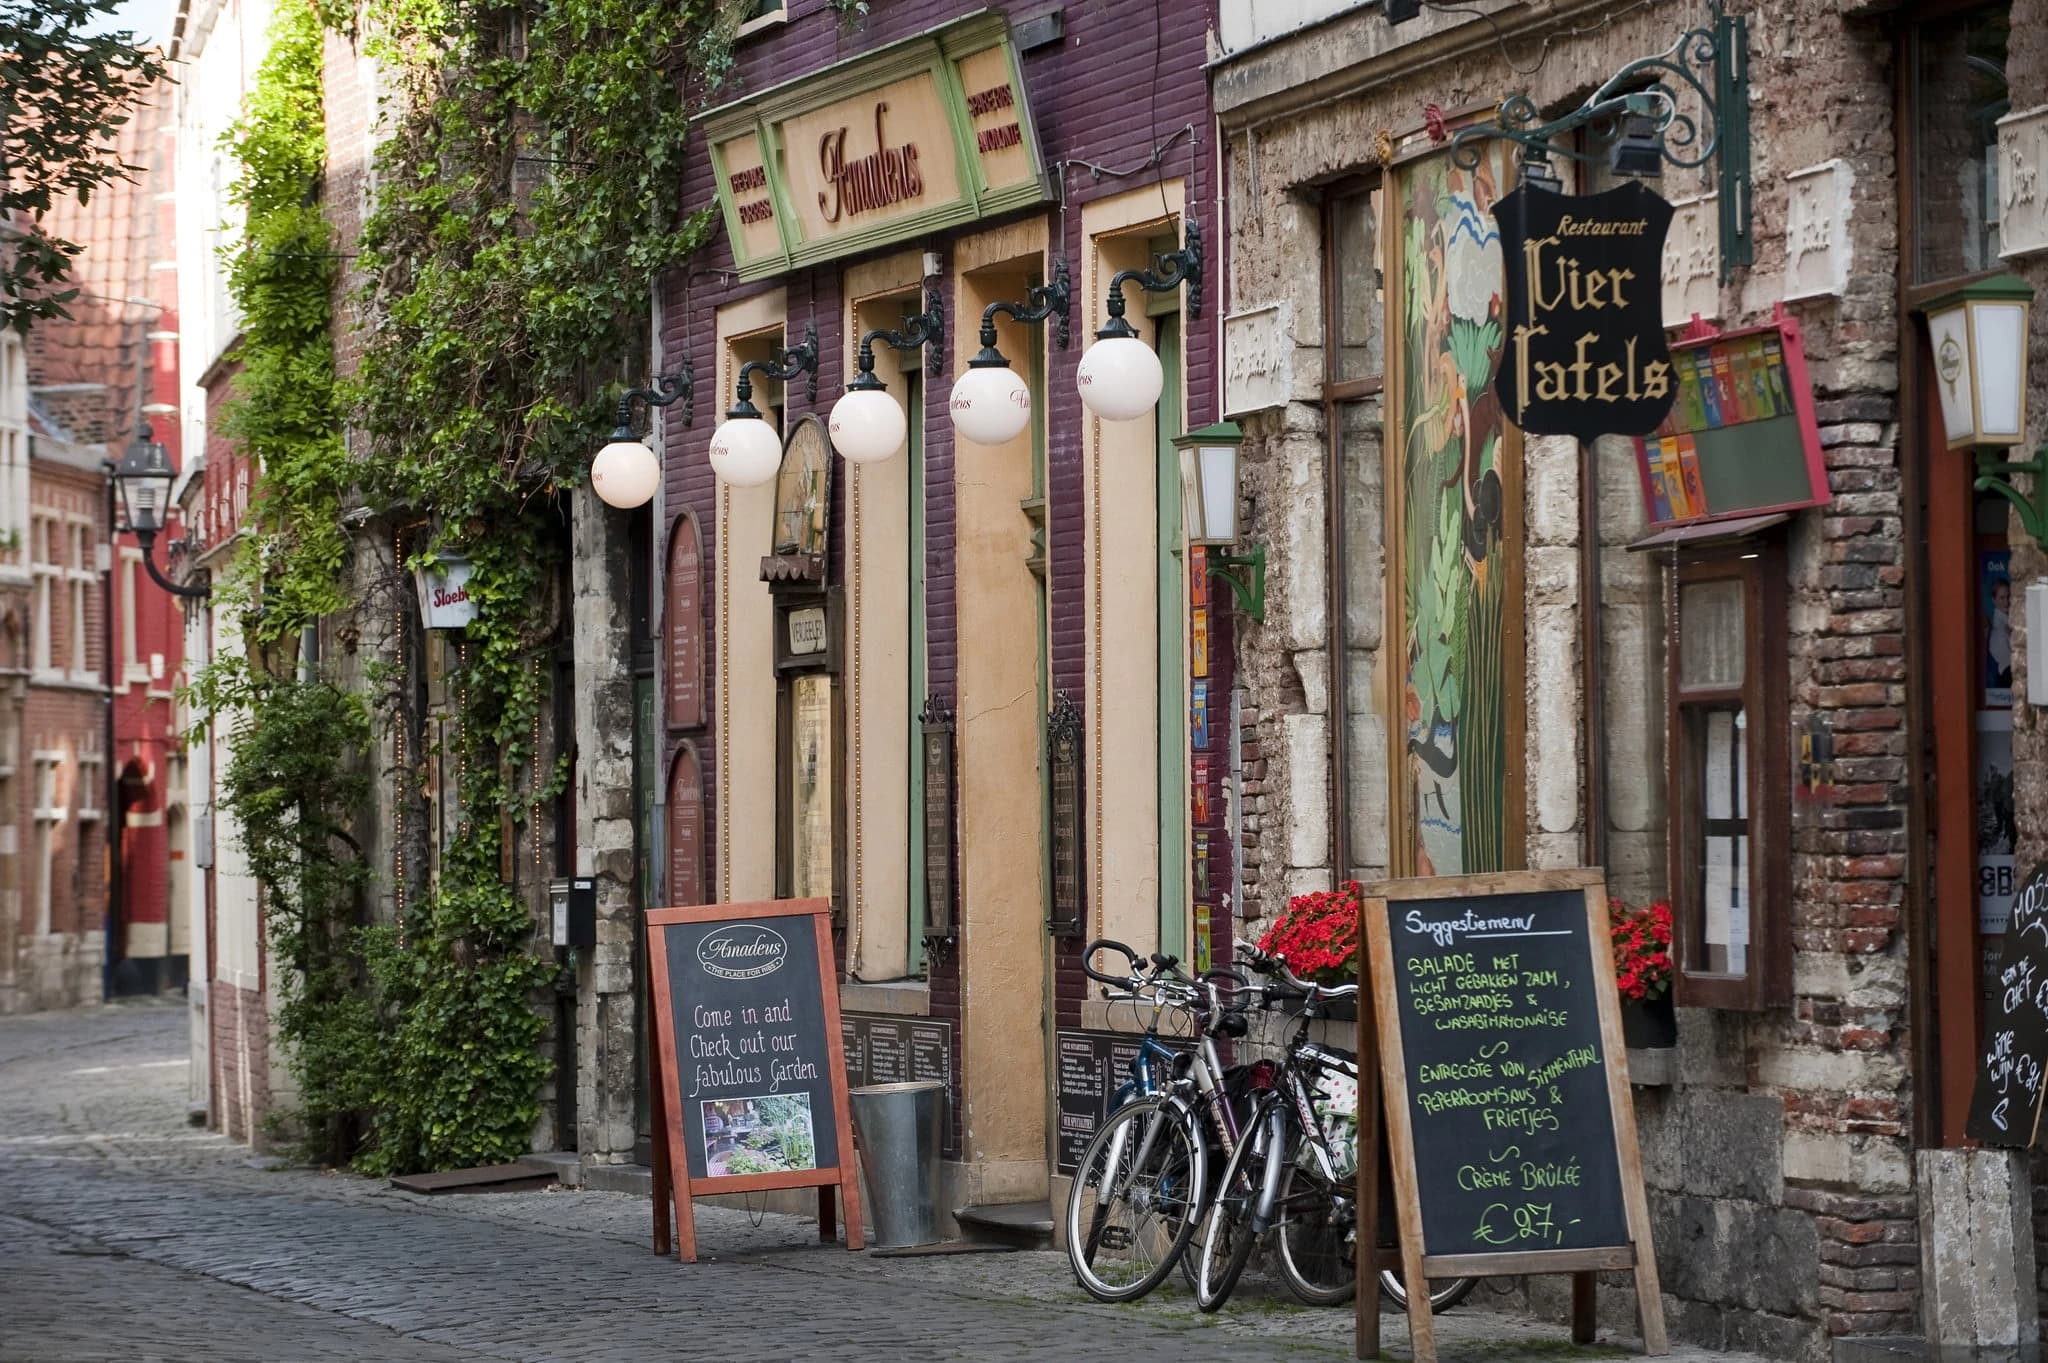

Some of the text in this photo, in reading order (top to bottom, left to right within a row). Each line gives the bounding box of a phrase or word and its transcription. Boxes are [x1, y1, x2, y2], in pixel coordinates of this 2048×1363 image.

[1556, 214, 1648, 236] Restaurant
[1522, 236, 1636, 328] Vier
[1512, 324, 1671, 425] Tafels
[702, 933, 781, 960] Amadeus
[711, 963, 777, 978] THE PLACE FOR RIBS
[1407, 953, 1520, 977] SALADE MET
[1410, 976, 1448, 994] LICHT
[1455, 972, 1519, 990] GEBAKKEN
[2003, 965, 2037, 1015] CHEF
[694, 998, 793, 1029] Come in and
[690, 1029, 798, 1060] Check out our
[689, 1061, 762, 1098] fabulous
[1419, 1058, 1493, 1083] ENTRECÔTE
[1500, 1061, 1526, 1077] VAN
[1549, 1086, 1564, 1104] &
